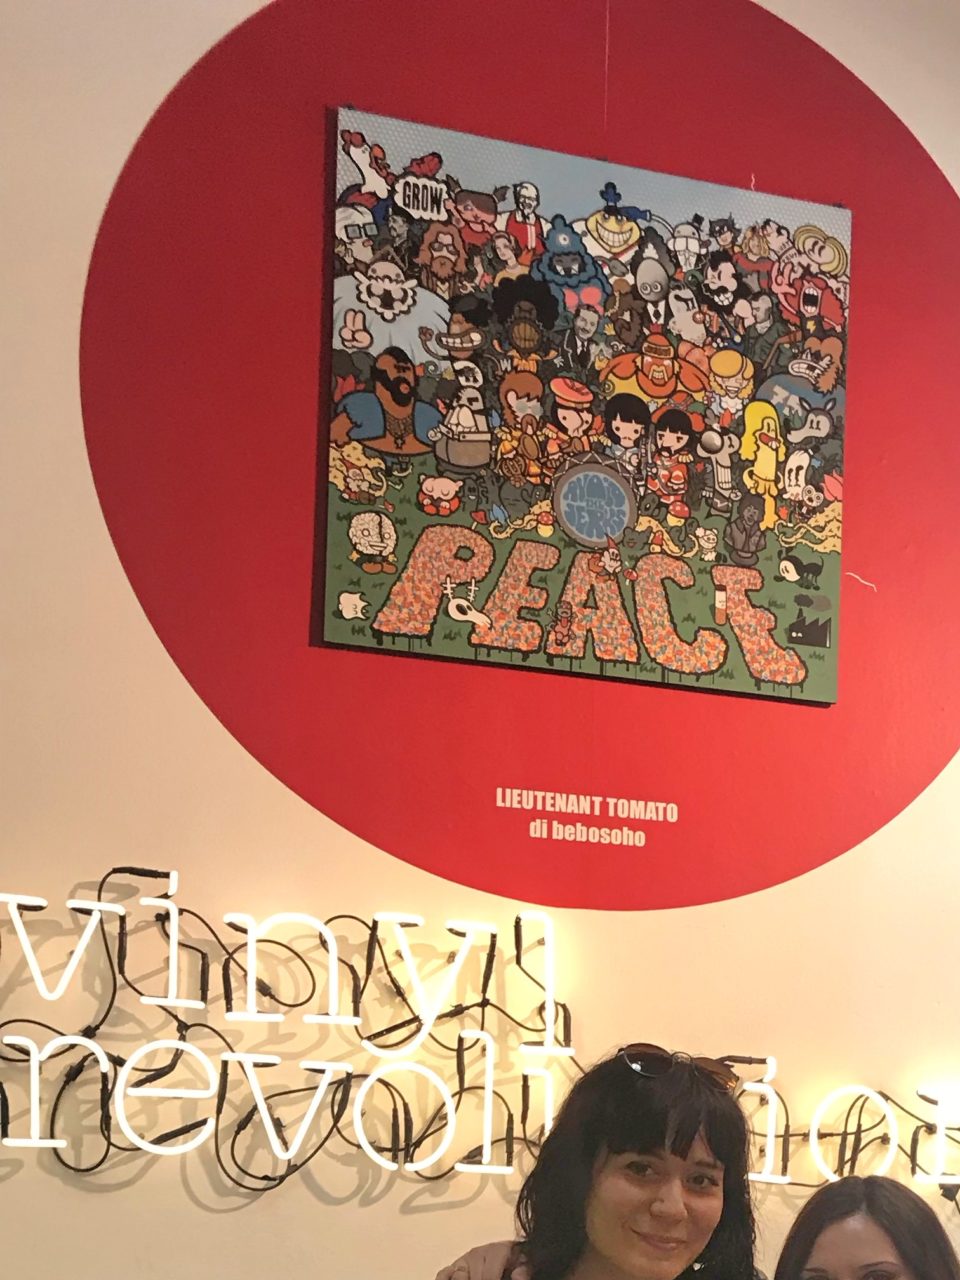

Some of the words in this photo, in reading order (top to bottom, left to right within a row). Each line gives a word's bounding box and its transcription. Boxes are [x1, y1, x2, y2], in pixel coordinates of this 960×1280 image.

[403, 180, 443, 216] GROW
[371, 523, 808, 686] PEACE
[496, 787, 603, 816] LIEUTENANT
[606, 797, 679, 823] TOMATO
[529, 818, 548, 839] di
[552, 820, 646, 847] bebosoho
[0, 869, 576, 1058] vinyl
